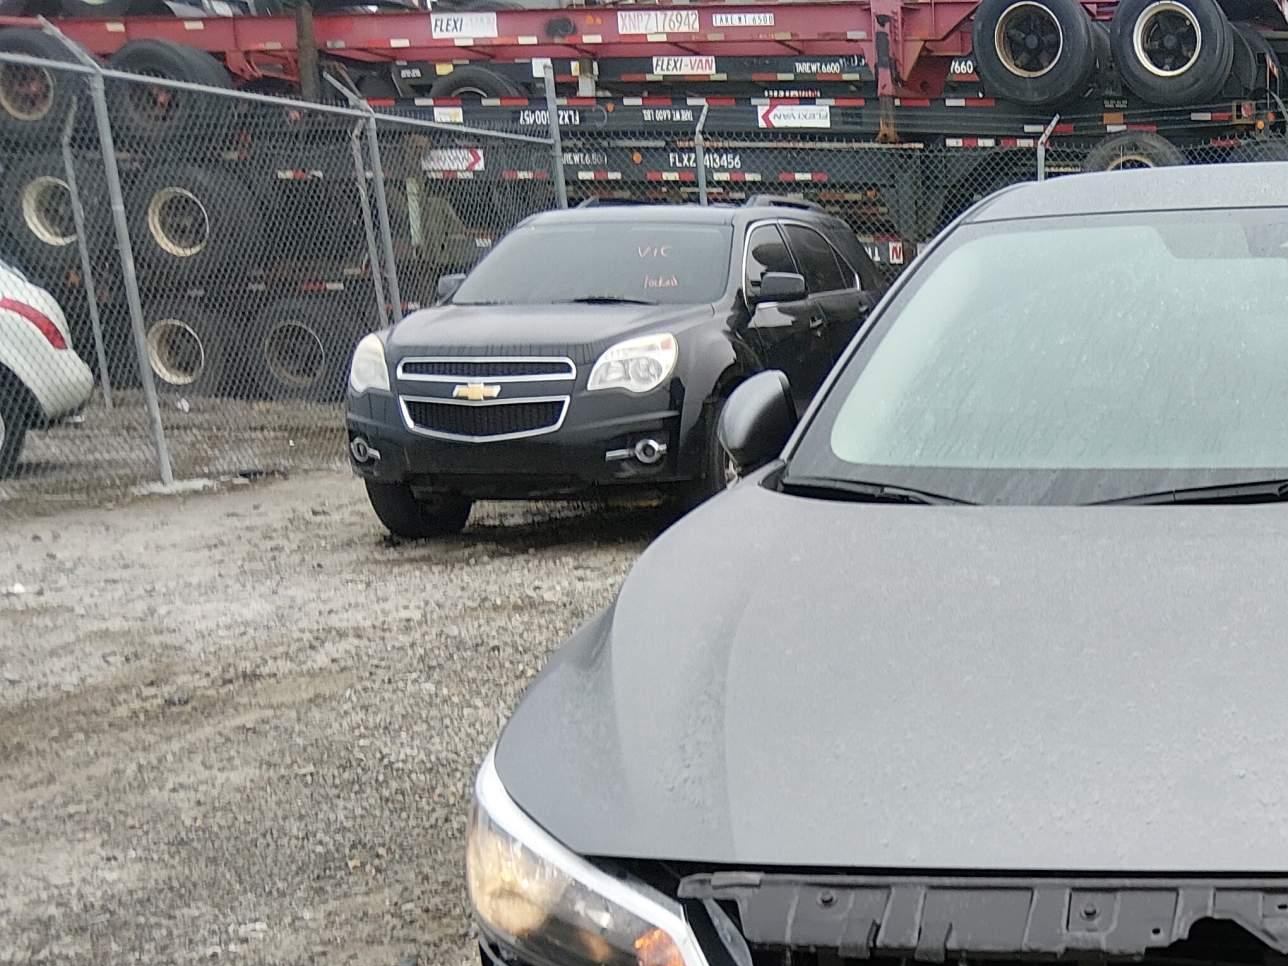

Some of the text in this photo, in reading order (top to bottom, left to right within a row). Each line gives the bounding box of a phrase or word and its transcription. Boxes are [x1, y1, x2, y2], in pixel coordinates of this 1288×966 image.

[655, 59, 714, 71] FLEXI-VAN
[557, 110, 580, 125] FLXZ
[669, 153, 742, 169] FLXZ 413456
